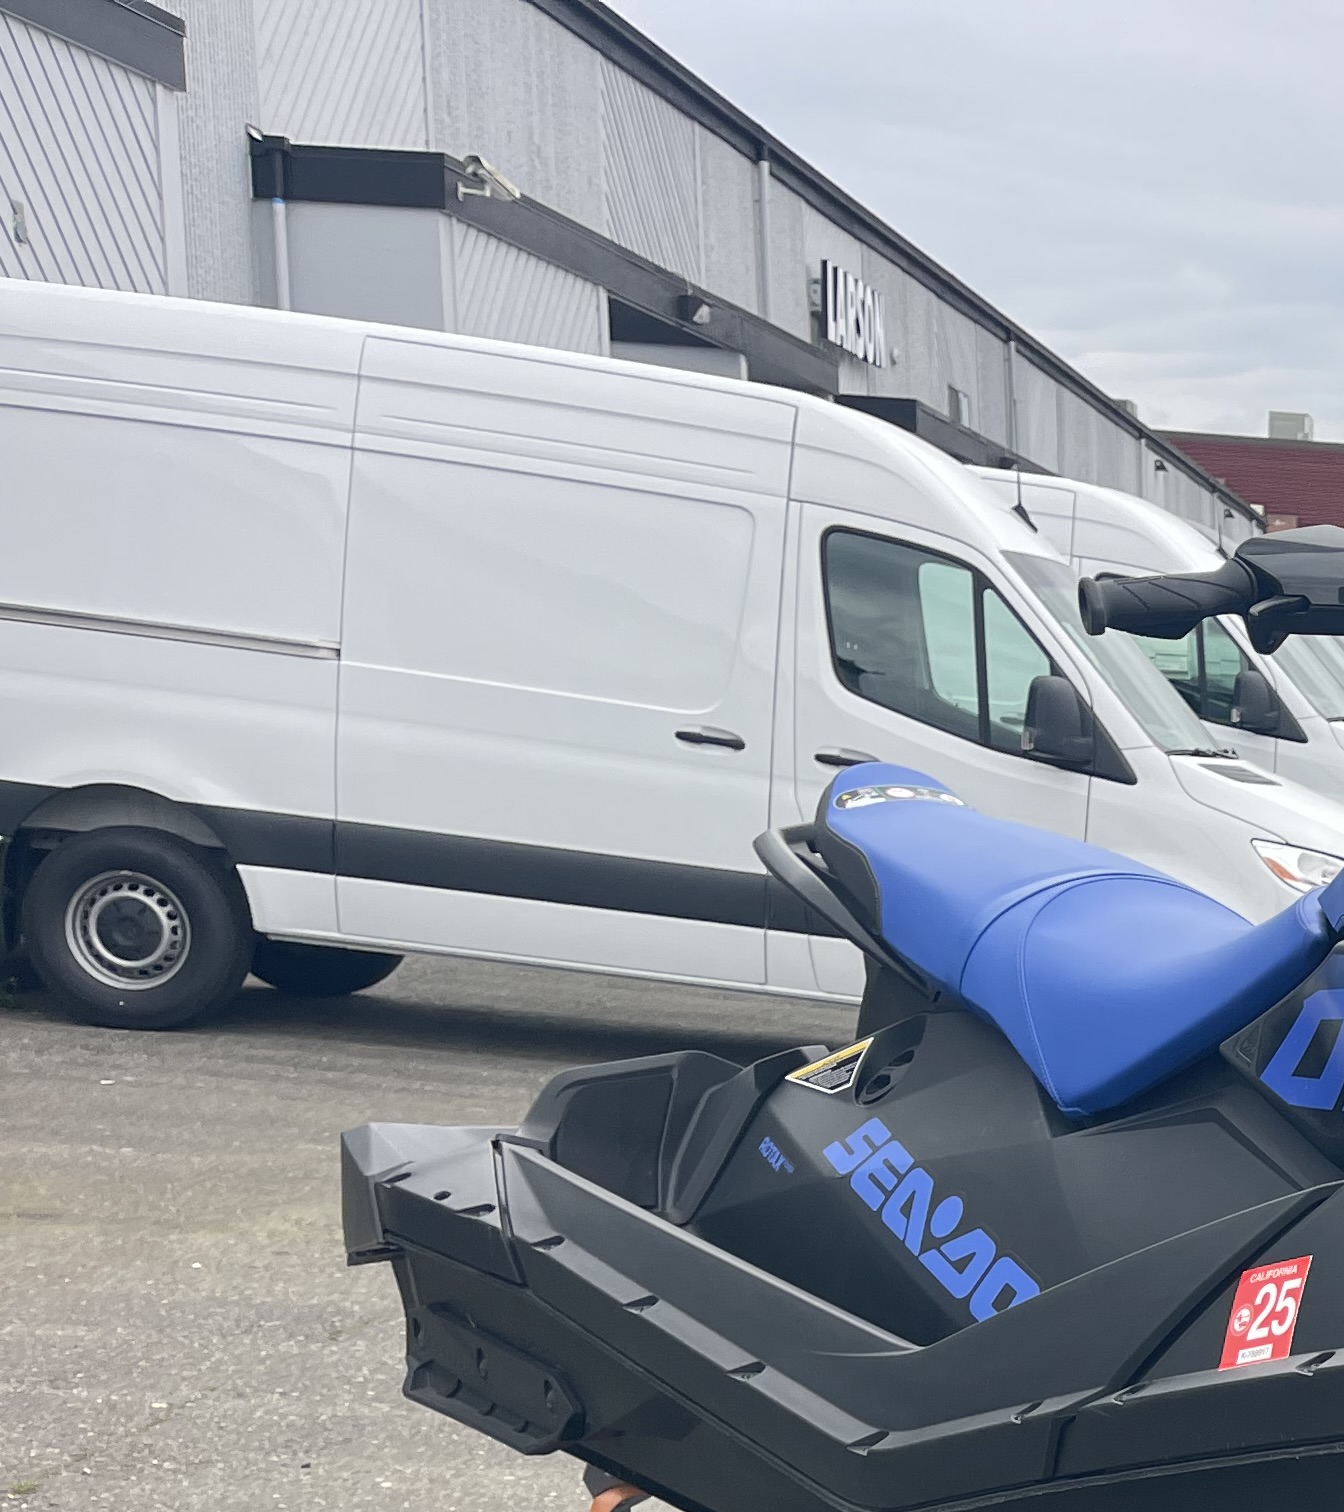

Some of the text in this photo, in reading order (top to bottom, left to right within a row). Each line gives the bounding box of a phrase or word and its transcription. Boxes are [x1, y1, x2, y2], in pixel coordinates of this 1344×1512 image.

[821, 259, 887, 369] LARSON
[1249, 1264, 1298, 1284] CALIFORNIA
[1246, 1278, 1303, 1342] 25
